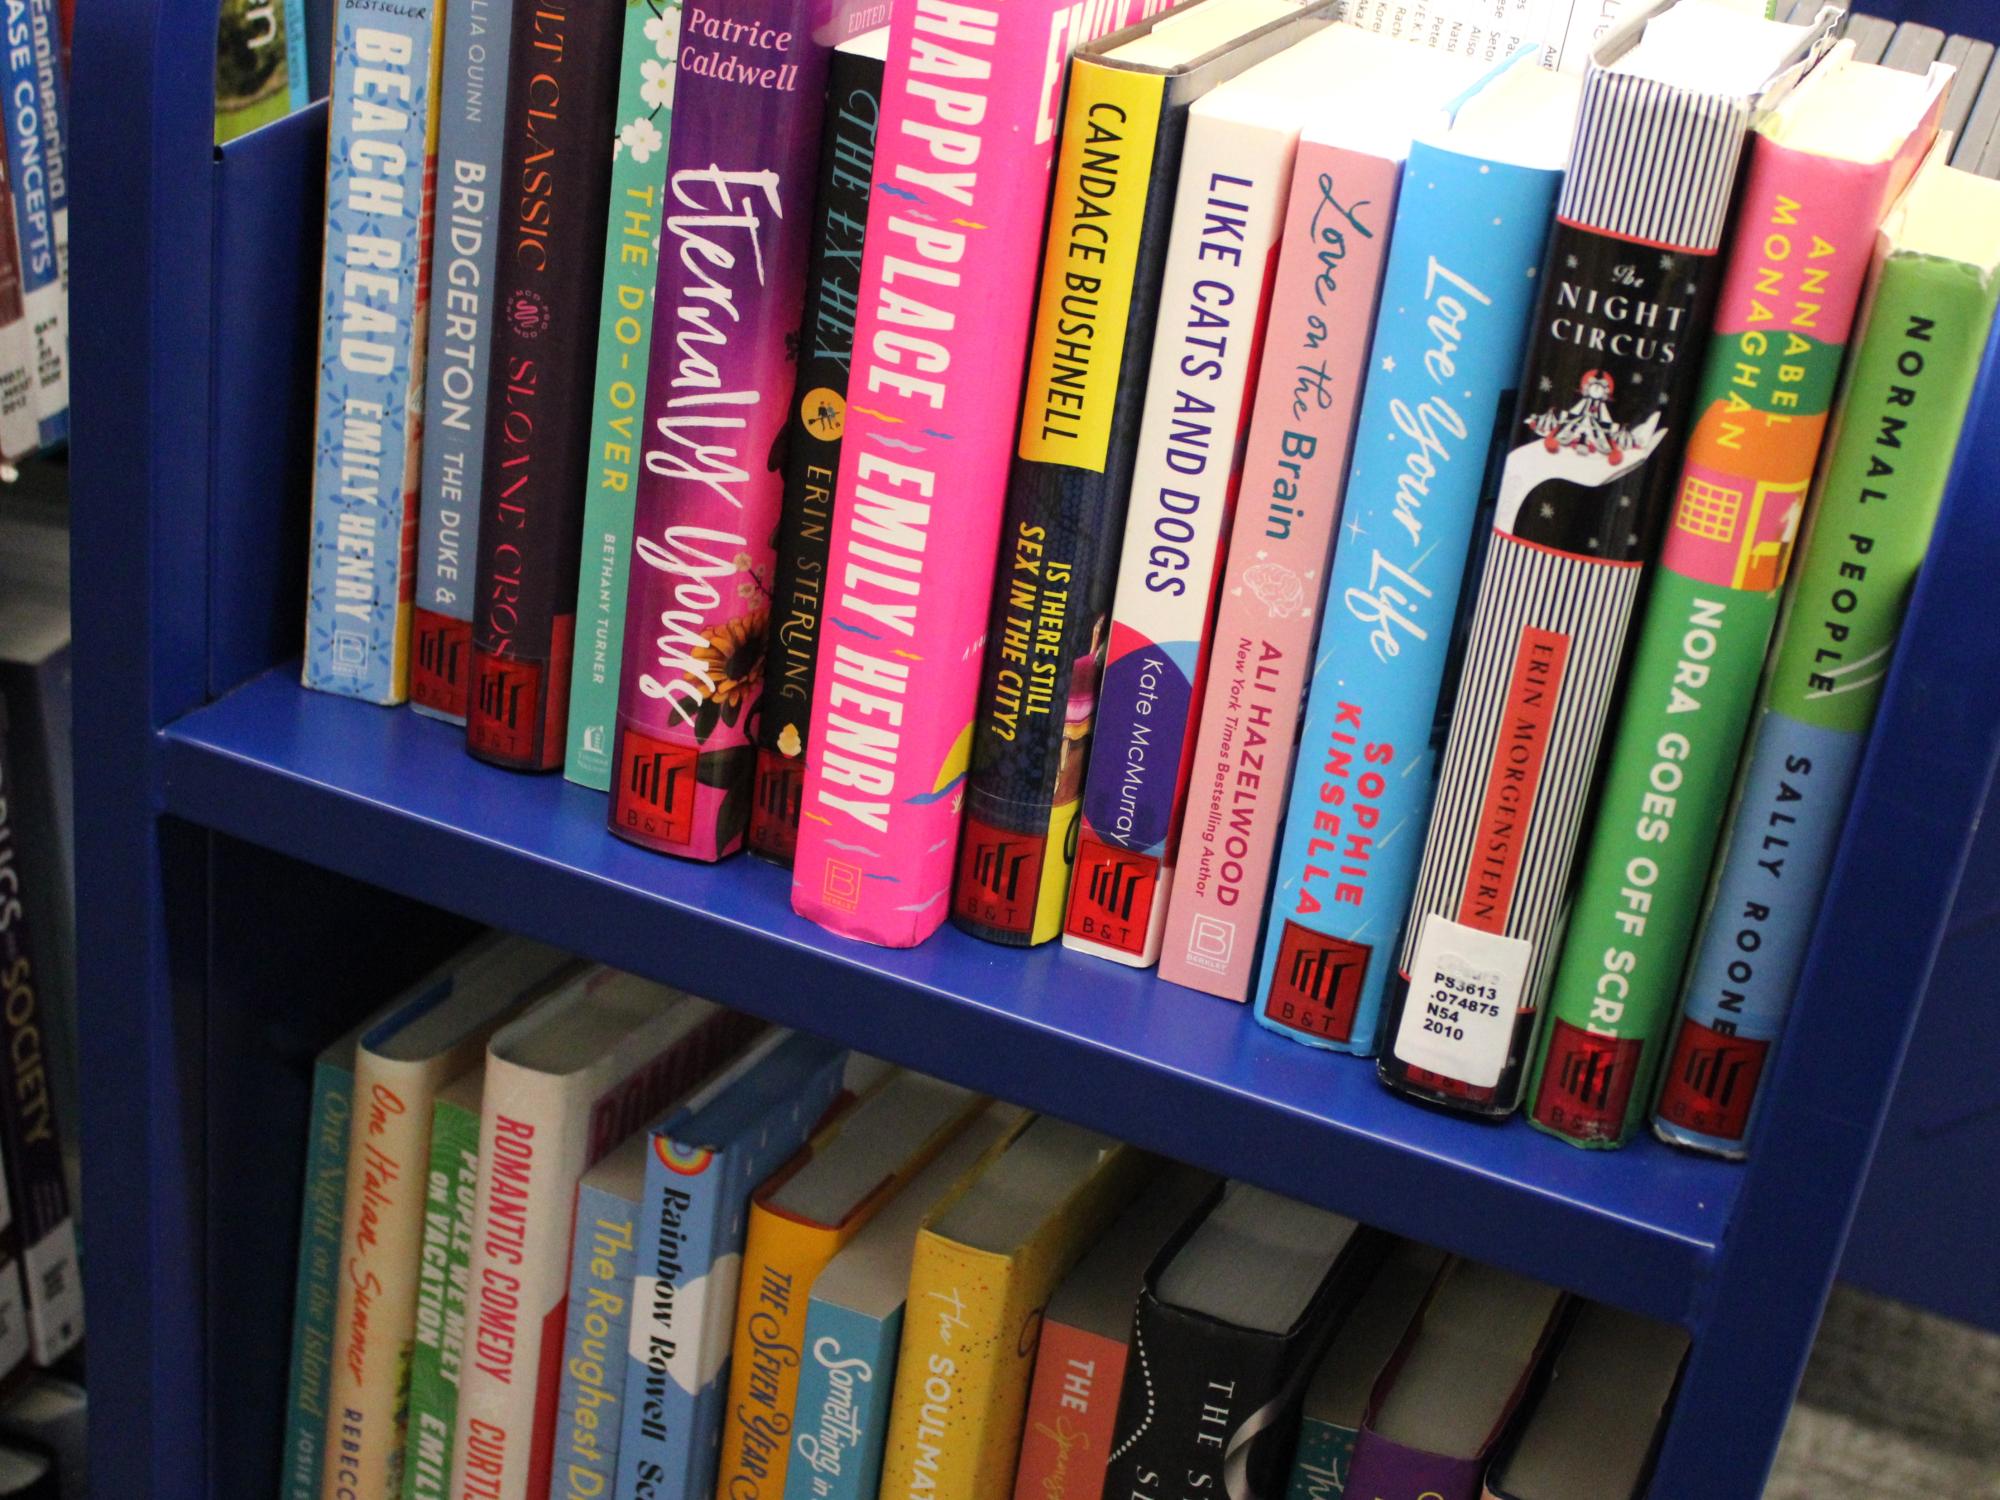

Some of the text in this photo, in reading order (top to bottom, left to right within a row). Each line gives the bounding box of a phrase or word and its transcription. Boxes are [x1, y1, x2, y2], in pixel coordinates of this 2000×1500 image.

[465, 43, 487, 123] QUINN
[534, 0, 565, 63] LT
[680, 46, 799, 92] Caldwell
[688, 8, 793, 52] Patrice
[848, 6, 887, 33] EDITED
[14, 81, 50, 275] CONCEPTS
[340, 27, 413, 377] BEACH READ
[517, 73, 560, 272] CLASSIC
[814, 89, 880, 374] THE EX HEX
[867, 0, 999, 409] HAPPY PLACE
[601, 186, 654, 493] THE DO-OVER
[1042, 102, 1127, 441] CANDACE BUSHNELL
[1551, 318, 1676, 364] CIRCUS
[1557, 281, 1687, 332] NIGHT
[1612, 263, 1645, 289] The
[1716, 195, 1801, 450] MONAGHAN
[1765, 235, 1836, 428] ANNABEL
[434, 159, 487, 605] BRIDGERTON THE DUKE &
[1145, 172, 1254, 597] LIKE CATS AND DOGS
[1265, 172, 1373, 541] Love on the Brain
[341, 398, 384, 506] EMILY
[498, 357, 539, 529] SLOANE
[636, 162, 783, 728] Eternally Yours
[1345, 255, 1491, 664] Love Your Life
[1807, 315, 1935, 693] NORMAL PEOPLE
[335, 513, 377, 623] HENRY
[592, 533, 617, 684] BETHANY TURNER
[779, 464, 832, 700] ERIN STERLING
[817, 451, 936, 833] EMILY HENRY
[992, 521, 1046, 742] SEX IN THE CITY?
[1025, 561, 1072, 716] IS THERE STILL
[1666, 597, 1727, 714] NORA
[627, 808, 638, 826] B
[664, 820, 675, 837] T
[1110, 657, 1164, 847] Kate McMurray
[1196, 637, 1253, 898] New York Times Bestselling Author
[1216, 640, 1283, 907] ALI HAZELWOOD
[1296, 700, 1363, 914] KINSELLA
[1334, 742, 1395, 907] SOPHIE
[1474, 642, 1554, 921] ERIN MORGENSTERN
[1636, 732, 1690, 844] GOES
[1757, 753, 1813, 879] SALLY
[967, 898, 978, 913] B
[1006, 908, 1018, 924] T
[1083, 916, 1130, 945] B & T
[1615, 856, 1659, 937] OFF
[1, 955, 53, 1147] SOCIETY
[1281, 1002, 1336, 1033] B & T
[1423, 1018, 1464, 1041] 2010
[1426, 1002, 1460, 1023] N54
[1434, 971, 1498, 1000] PS3613
[347, 1082, 406, 1388] One Italian Summer
[417, 1170, 451, 1349] ON VACATION
[475, 1113, 535, 1384] ROMANTIC COMEDY
[591, 1218, 635, 1281] The
[652, 1186, 692, 1330] Rainbow
[760, 1264, 793, 1316] THE
[440, 1308, 466, 1390] MEET
[569, 1286, 625, 1463] Roughest
[641, 1334, 677, 1442] Rowell
[749, 1312, 800, 1410] SEVEN
[928, 1286, 969, 1348] The
[1061, 1358, 1095, 1414] THE
[737, 1403, 791, 1478] YEAR
[797, 1336, 872, 1497] Something in
[1197, 1379, 1236, 1449] THE
